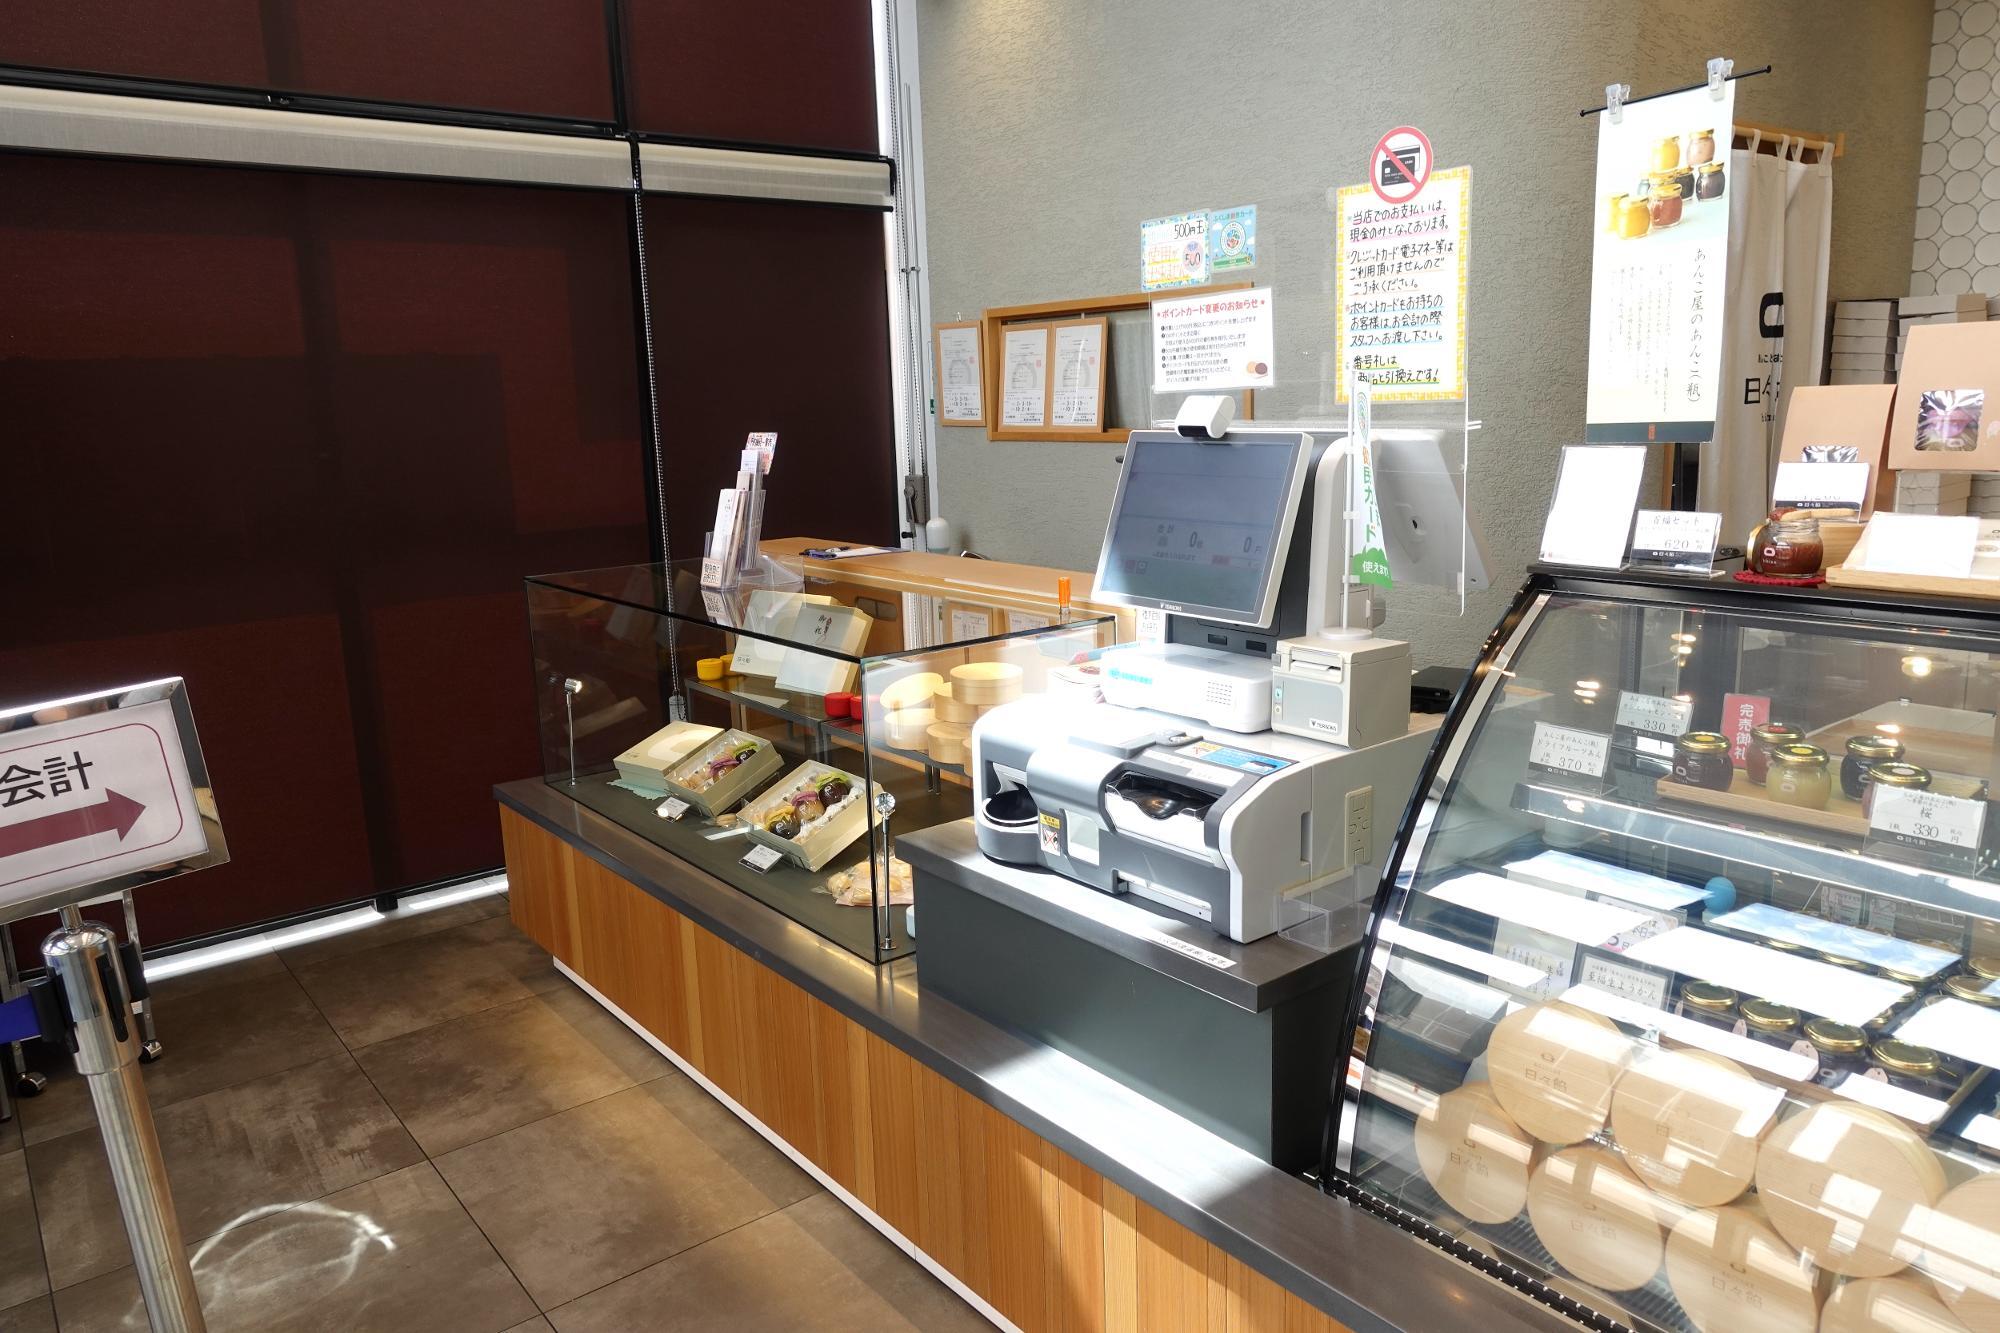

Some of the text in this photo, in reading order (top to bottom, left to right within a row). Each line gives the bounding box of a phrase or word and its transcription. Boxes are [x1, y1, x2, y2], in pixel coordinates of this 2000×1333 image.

[1161, 298, 1259, 319] ポイントカード変更のお知らせ
[1664, 539, 1690, 550] 620
[1643, 719, 1667, 732] 330
[1734, 703, 1755, 761] 完売御礼
[1558, 756, 1583, 771] 370
[0, 750, 94, 809] 会計
[1912, 822, 1939, 838] 330
